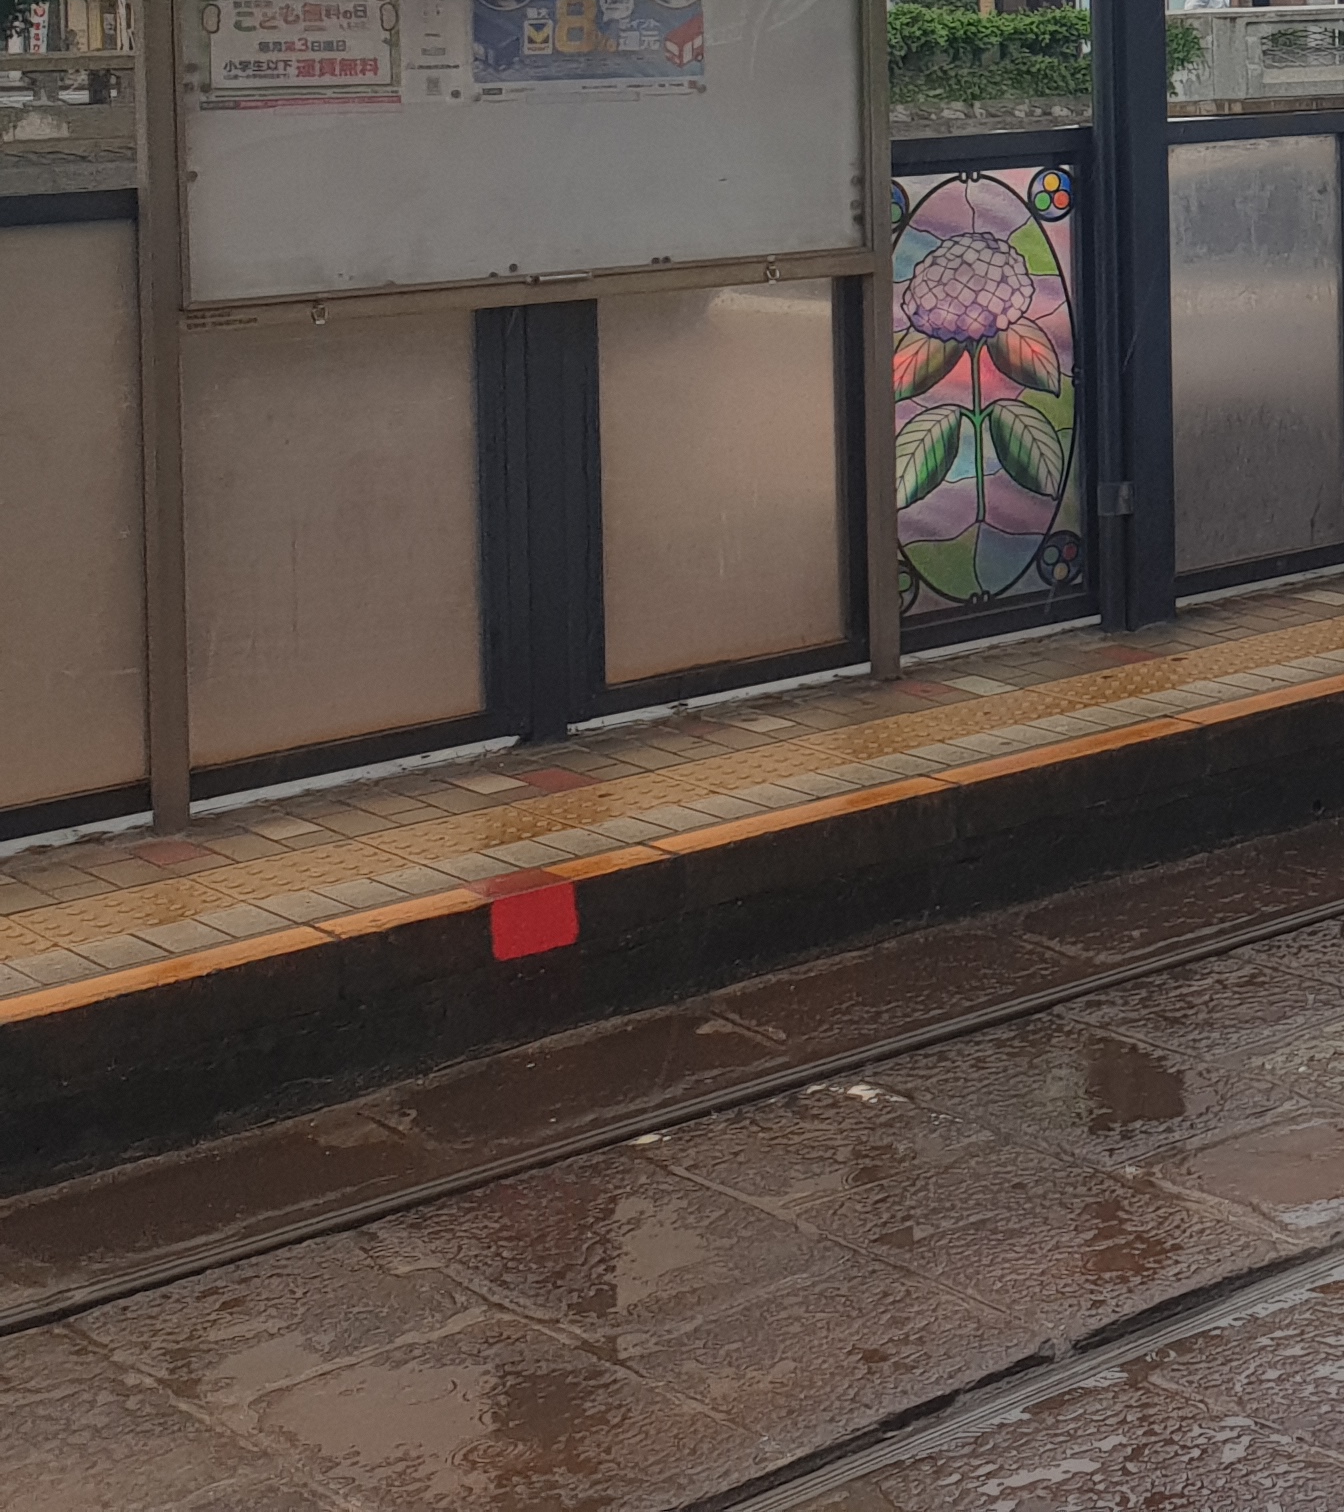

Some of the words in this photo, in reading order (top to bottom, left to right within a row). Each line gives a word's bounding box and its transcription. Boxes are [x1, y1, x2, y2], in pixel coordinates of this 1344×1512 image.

[223, 58, 293, 73] 小学生以下
[295, 56, 379, 79] 運賃無料
